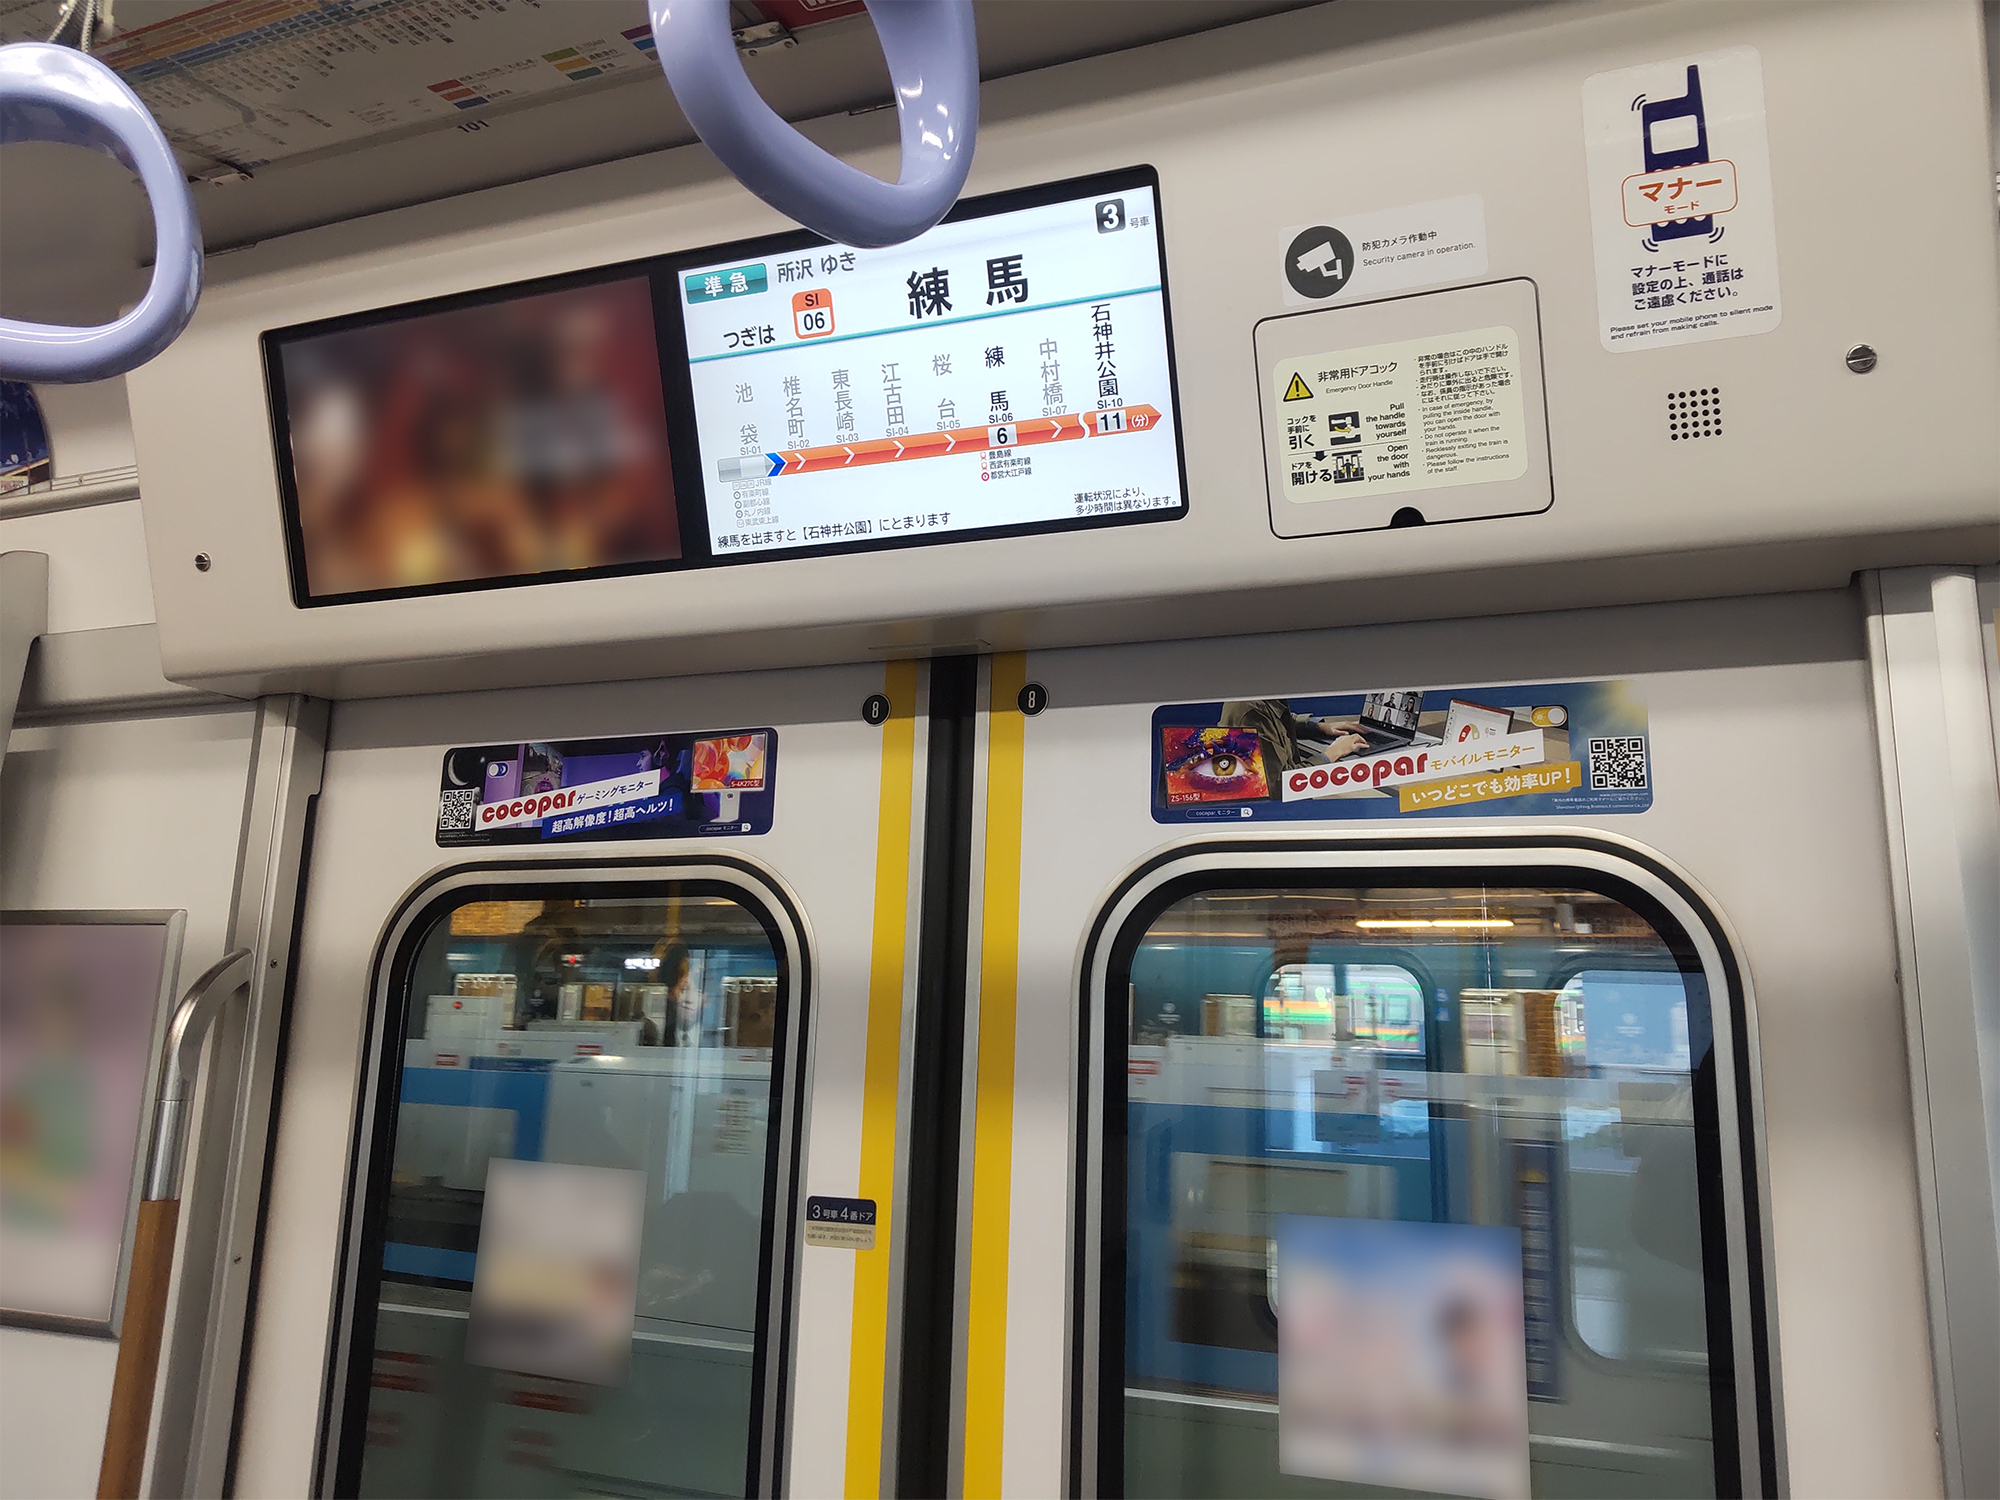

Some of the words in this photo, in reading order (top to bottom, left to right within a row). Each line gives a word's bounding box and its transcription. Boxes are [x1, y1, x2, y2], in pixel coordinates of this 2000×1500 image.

[457, 119, 489, 134] 101
[1638, 176, 1722, 203] マナー
[1102, 203, 1119, 229] 3
[1664, 201, 1700, 214] モード
[1129, 215, 1151, 229] 号車
[1362, 230, 1437, 252] 防犯カメラ作動中
[1363, 255, 1395, 267] Security
[1396, 251, 1425, 261] camera
[1427, 248, 1435, 256] in
[1436, 242, 1476, 255] operation.
[777, 258, 814, 283] 所沢
[820, 251, 856, 275] ゆき
[1631, 254, 1729, 278] マナーモードに
[704, 271, 749, 297] 準急
[906, 254, 1029, 319] 練馬
[1631, 268, 1744, 296] 設定の上、通話は
[804, 293, 819, 307] SI
[1634, 286, 1738, 311] ご遠慮ください。
[803, 312, 825, 331] 06
[1610, 323, 1635, 333] Please
[1669, 316, 1693, 325] mobile
[1695, 312, 1718, 322] phone
[1729, 307, 1751, 316] silent
[1752, 304, 1773, 313] mode
[723, 325, 776, 349] つぎは
[1625, 329, 1651, 338] refrain
[1652, 327, 1669, 335] from
[1671, 323, 1698, 333] making
[1699, 320, 1719, 328] calls.
[1091, 303, 1119, 397] 石神井公園
[984, 346, 1009, 412] 練馬
[1038, 337, 1064, 406] 中村橋
[1317, 361, 1398, 383] 非常用ドアコック
[881, 362, 905, 427] 江古田
[932, 353, 956, 420] 桜台
[1325, 384, 1357, 395] Emergency
[1358, 382, 1372, 390] Door
[1373, 379, 1393, 388] Handle
[783, 376, 805, 438] 椎名町
[831, 368, 855, 432] 東長崎
[1097, 397, 1123, 410] SI-10
[1389, 402, 1405, 411] Pull
[735, 383, 759, 445] 池袋
[988, 412, 1014, 424] SI-06
[1042, 405, 1067, 417] SI-07
[1287, 415, 1316, 425] コックを
[1365, 415, 1378, 423] the
[1379, 411, 1406, 421] handle
[1422, 411, 1441, 420] pulling
[936, 419, 961, 431] SI-05
[1099, 412, 1122, 431] 11
[1287, 424, 1310, 435] 手前に
[1375, 420, 1407, 430] towards
[836, 433, 860, 444] SI-03
[885, 426, 910, 438] SI-04
[997, 427, 1008, 445] 6
[1375, 428, 1407, 440] yourself
[1444, 430, 1467, 438] operate
[740, 445, 762, 456] SI-01
[788, 439, 810, 450] SI-02
[1288, 433, 1315, 450] 引く
[1387, 444, 1408, 453] Open
[1425, 445, 1456, 453] Recklessly
[1291, 461, 1312, 471] ドアを
[1377, 454, 1389, 462] the
[1390, 452, 1409, 461] door
[1393, 461, 1410, 469] with
[1476, 453, 1510, 461] instructions
[1291, 469, 1332, 486] 開ける
[1367, 473, 1385, 482] your
[1386, 469, 1411, 479] hands
[1074, 486, 1146, 504] 運転状況により、
[1075, 495, 1177, 516] 多少時間は異なります。
[717, 511, 951, 549] 練馬を出ますと【石神井公園】にとまります
[1028, 690, 1036, 709] 8
[871, 701, 880, 718] 8
[1430, 744, 1536, 771] モバイルモニター
[1289, 752, 1428, 793] cocopar
[576, 780, 654, 805] ゲーミングモニター
[1412, 767, 1571, 804] いつどこでも効率UP！
[482, 790, 576, 823] cocopar
